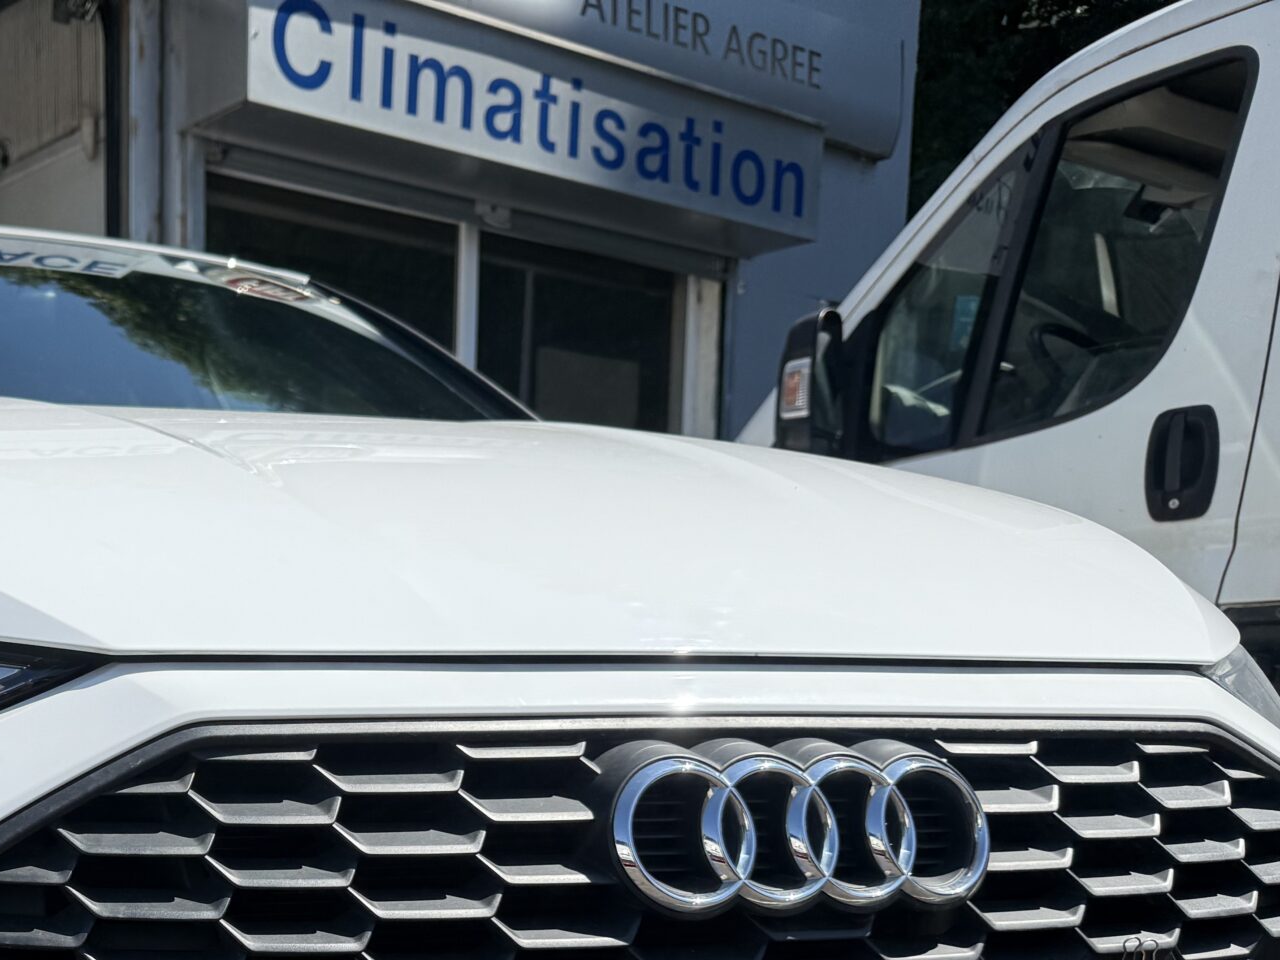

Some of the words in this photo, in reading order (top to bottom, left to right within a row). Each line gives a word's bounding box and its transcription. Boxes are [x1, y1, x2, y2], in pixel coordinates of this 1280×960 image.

[273, 0, 805, 218] Climatisation
[580, 0, 710, 55] ATELIER
[724, 25, 822, 89] AGREE
